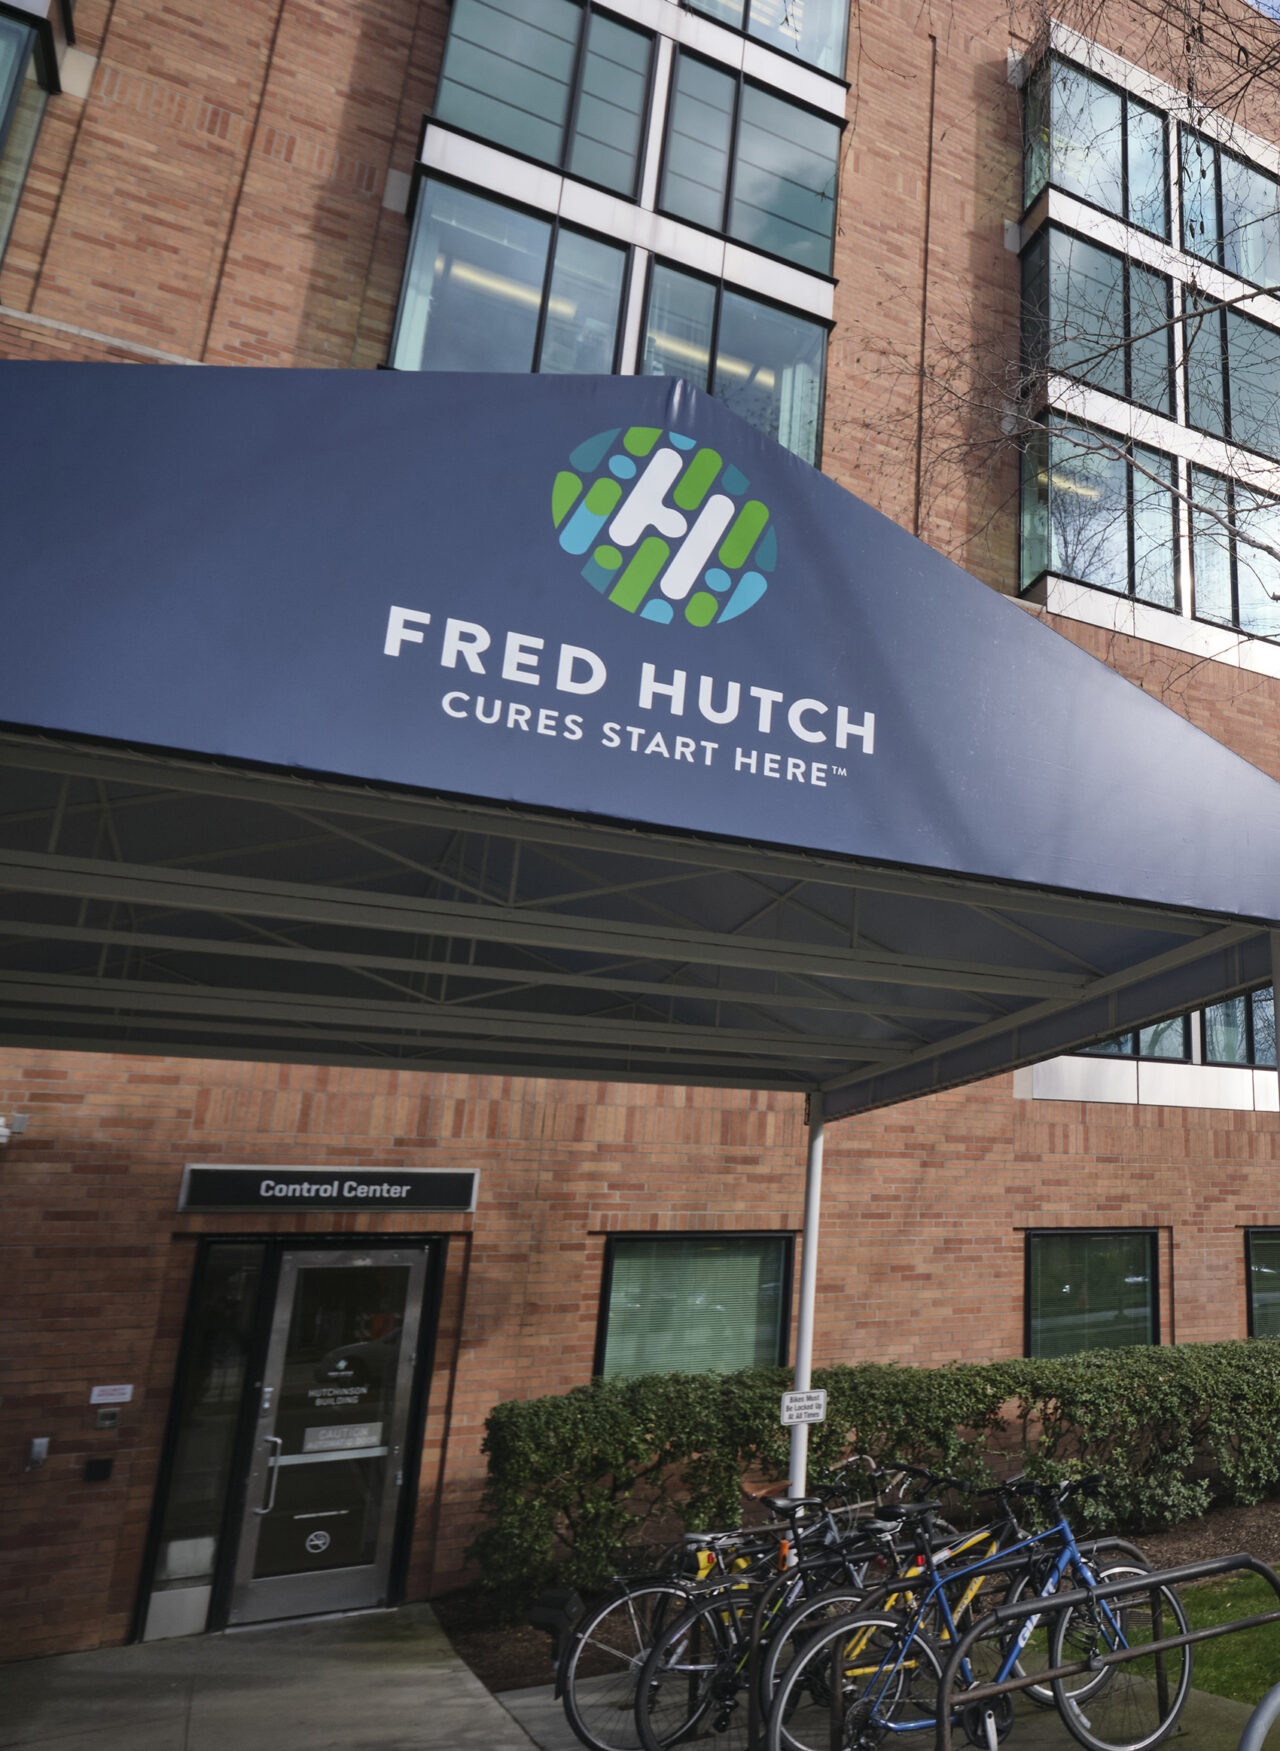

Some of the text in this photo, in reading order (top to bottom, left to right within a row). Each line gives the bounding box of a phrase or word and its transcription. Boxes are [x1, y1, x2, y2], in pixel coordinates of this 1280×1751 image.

[384, 605, 876, 754] FRED HUTCH
[441, 691, 584, 740] CURES
[601, 722, 719, 766] START
[259, 1180, 412, 1198] Control Center
[308, 1387, 368, 1397] HUTCHINSON
[315, 1396, 359, 1406] BUILDING
[794, 1403, 814, 1411] Locked
[318, 1428, 369, 1440] CAUTION
